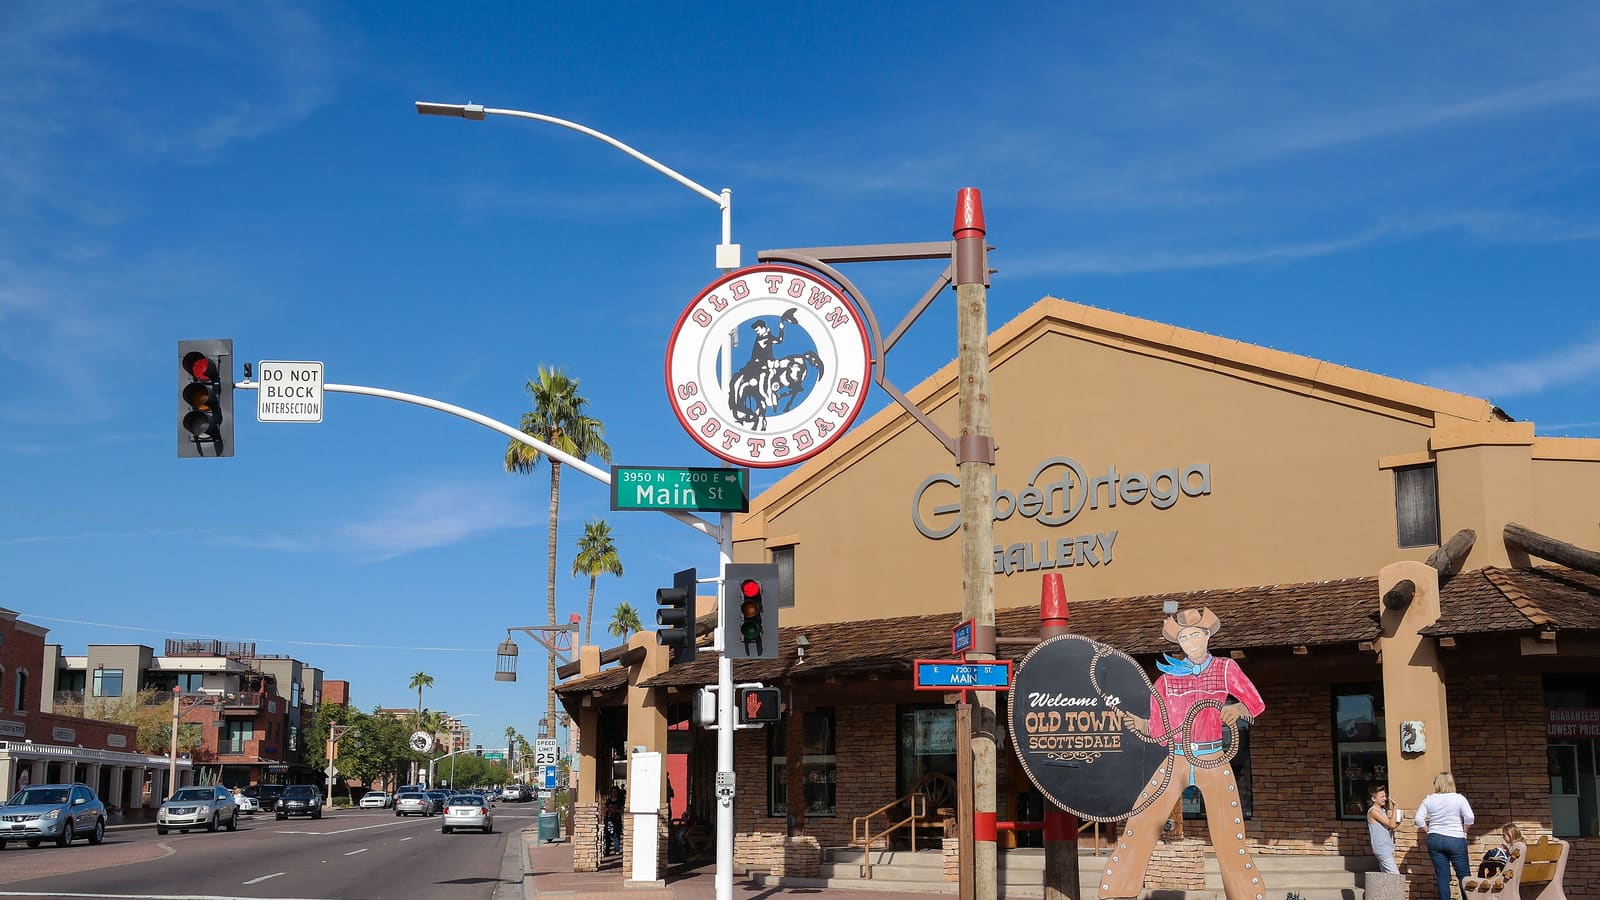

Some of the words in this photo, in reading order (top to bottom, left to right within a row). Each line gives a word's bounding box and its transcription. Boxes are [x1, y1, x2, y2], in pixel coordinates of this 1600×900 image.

[692, 280, 750, 328] OLD
[765, 275, 849, 328] TOWN
[263, 369, 283, 381] DO
[290, 370, 318, 381] NOT
[267, 386, 314, 398] BLOCK
[262, 402, 319, 414] INTERSECTION
[678, 378, 859, 458] SCOTTSDALE
[623, 472, 652, 482] 3950
[657, 473, 665, 482] N
[680, 473, 708, 483] 7200
[713, 474, 719, 483] E
[636, 483, 696, 505] Main
[708, 487, 724, 500] St
[911, 472, 1074, 540] Gbert
[950, 674, 977, 683] MAIN
[1028, 692, 1098, 708] Welcome
[1105, 694, 1121, 707] to
[1025, 711, 1062, 733] OLD
[1065, 711, 1123, 733] TOWN
[1548, 724, 1577, 735] LOWEST
[1028, 735, 1121, 749] SCOTTSDALE
[537, 753, 555, 764] 25
